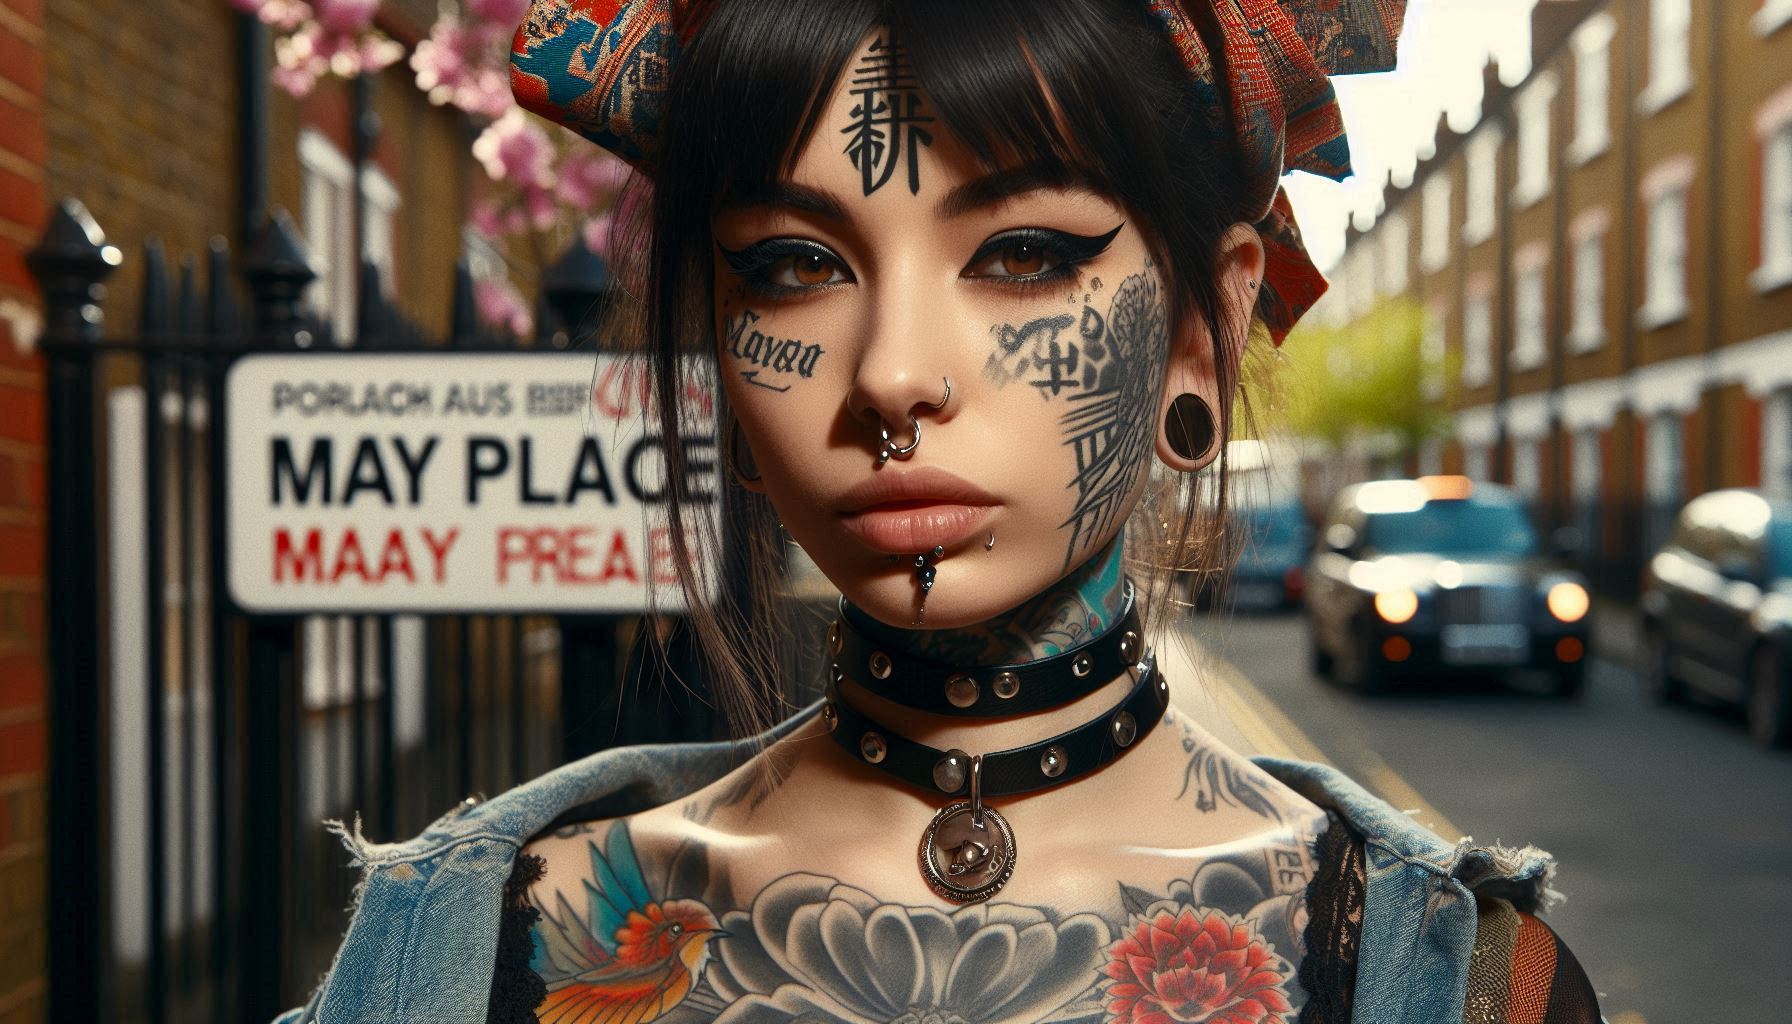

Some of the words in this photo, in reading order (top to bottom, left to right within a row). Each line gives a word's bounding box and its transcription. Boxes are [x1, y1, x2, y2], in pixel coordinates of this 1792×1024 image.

[271, 434, 440, 505] MAY
[466, 434, 717, 505] PLACE
[272, 527, 460, 584] MAAY
